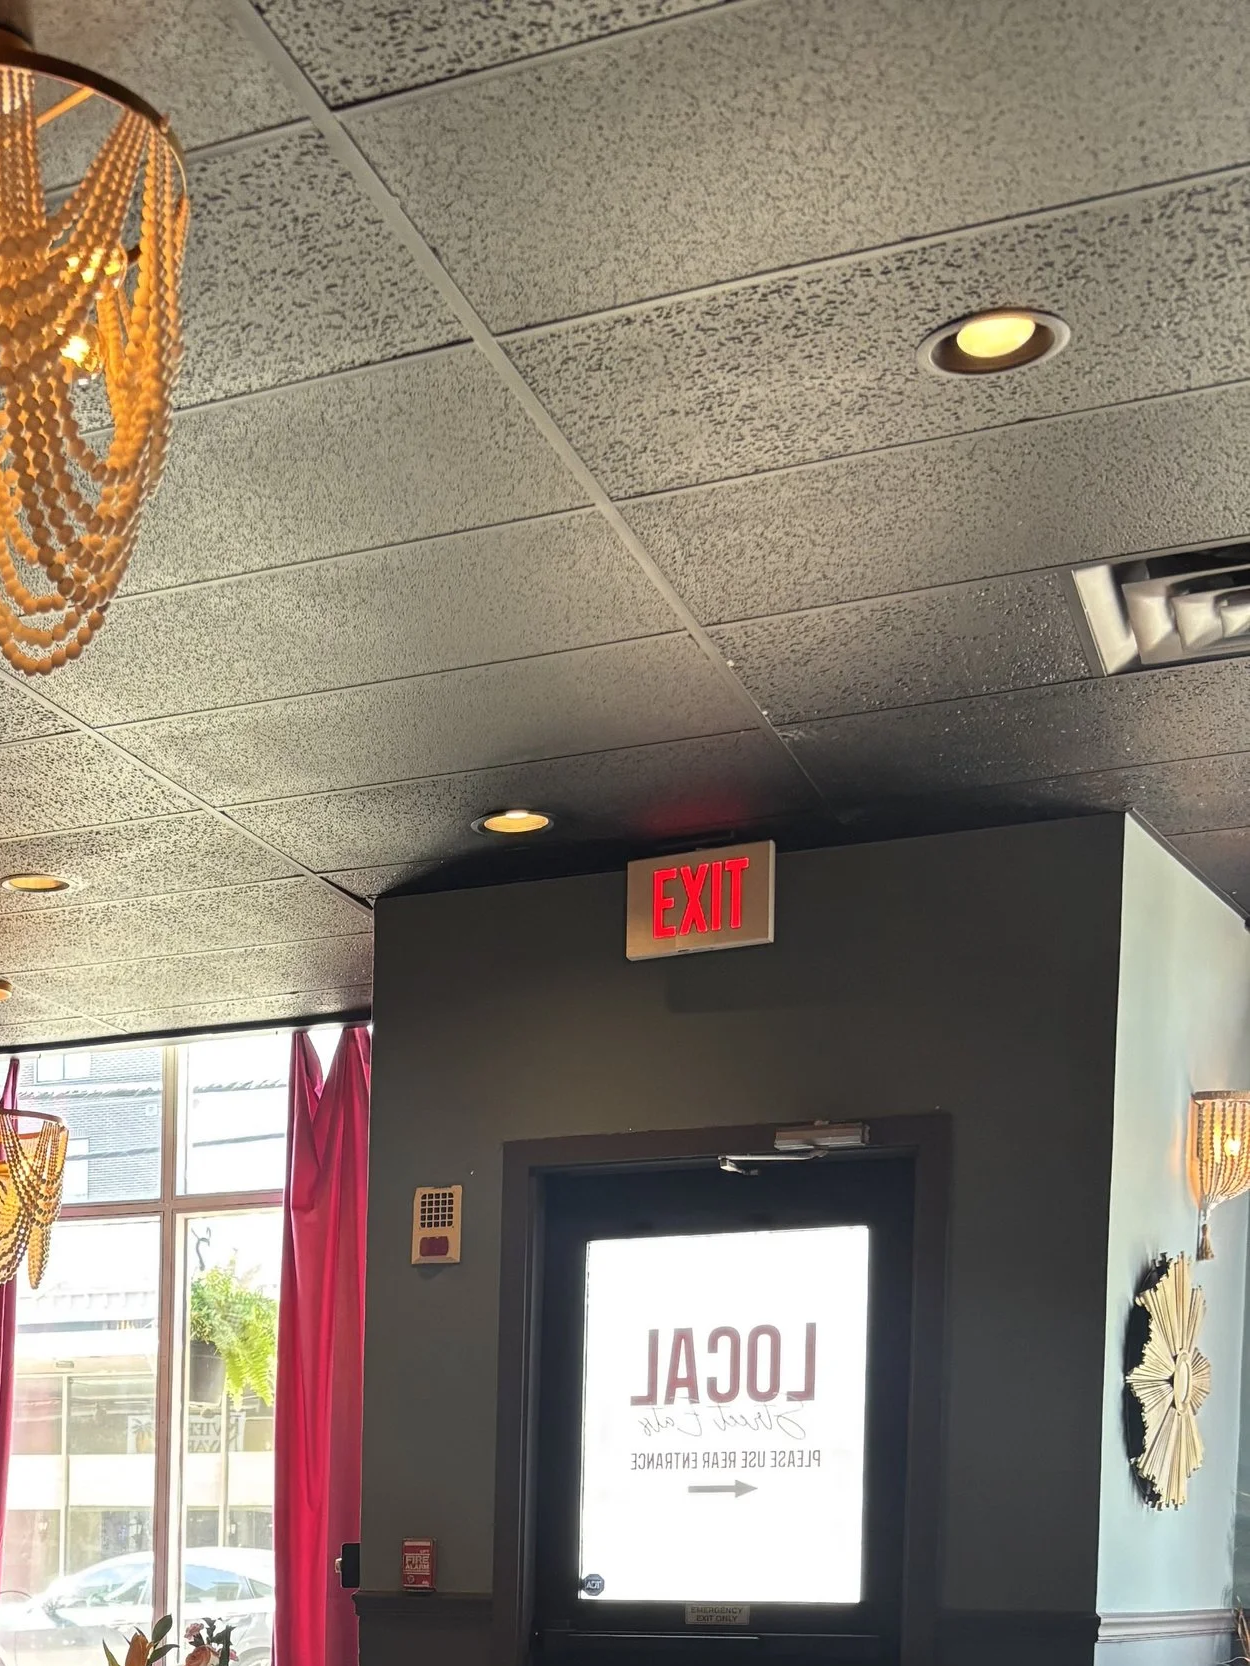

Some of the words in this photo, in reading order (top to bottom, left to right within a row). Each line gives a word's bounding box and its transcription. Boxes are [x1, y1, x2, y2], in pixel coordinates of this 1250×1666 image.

[651, 857, 750, 940] EXIT
[405, 1555, 430, 1564] FIRE
[586, 1580, 602, 1589] ADT
[690, 1606, 743, 1614] EMERGENCY
[696, 1614, 714, 1622] EXIT
